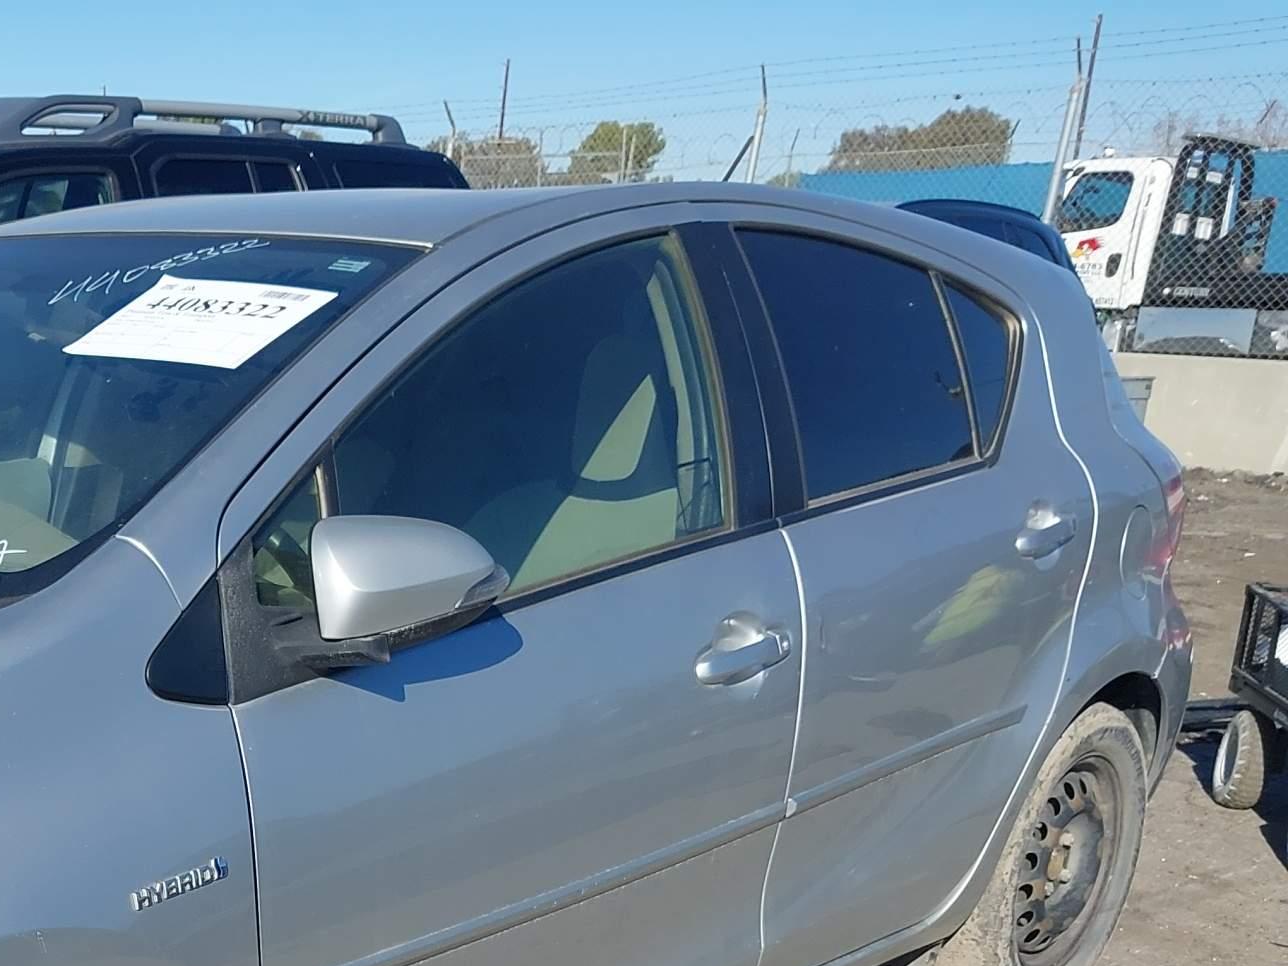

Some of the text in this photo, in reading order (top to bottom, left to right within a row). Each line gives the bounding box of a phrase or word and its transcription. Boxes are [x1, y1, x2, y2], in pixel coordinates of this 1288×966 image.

[47, 239, 271, 306] 44083322
[145, 295, 288, 320] 44083322
[131, 865, 217, 911] HYBRID
